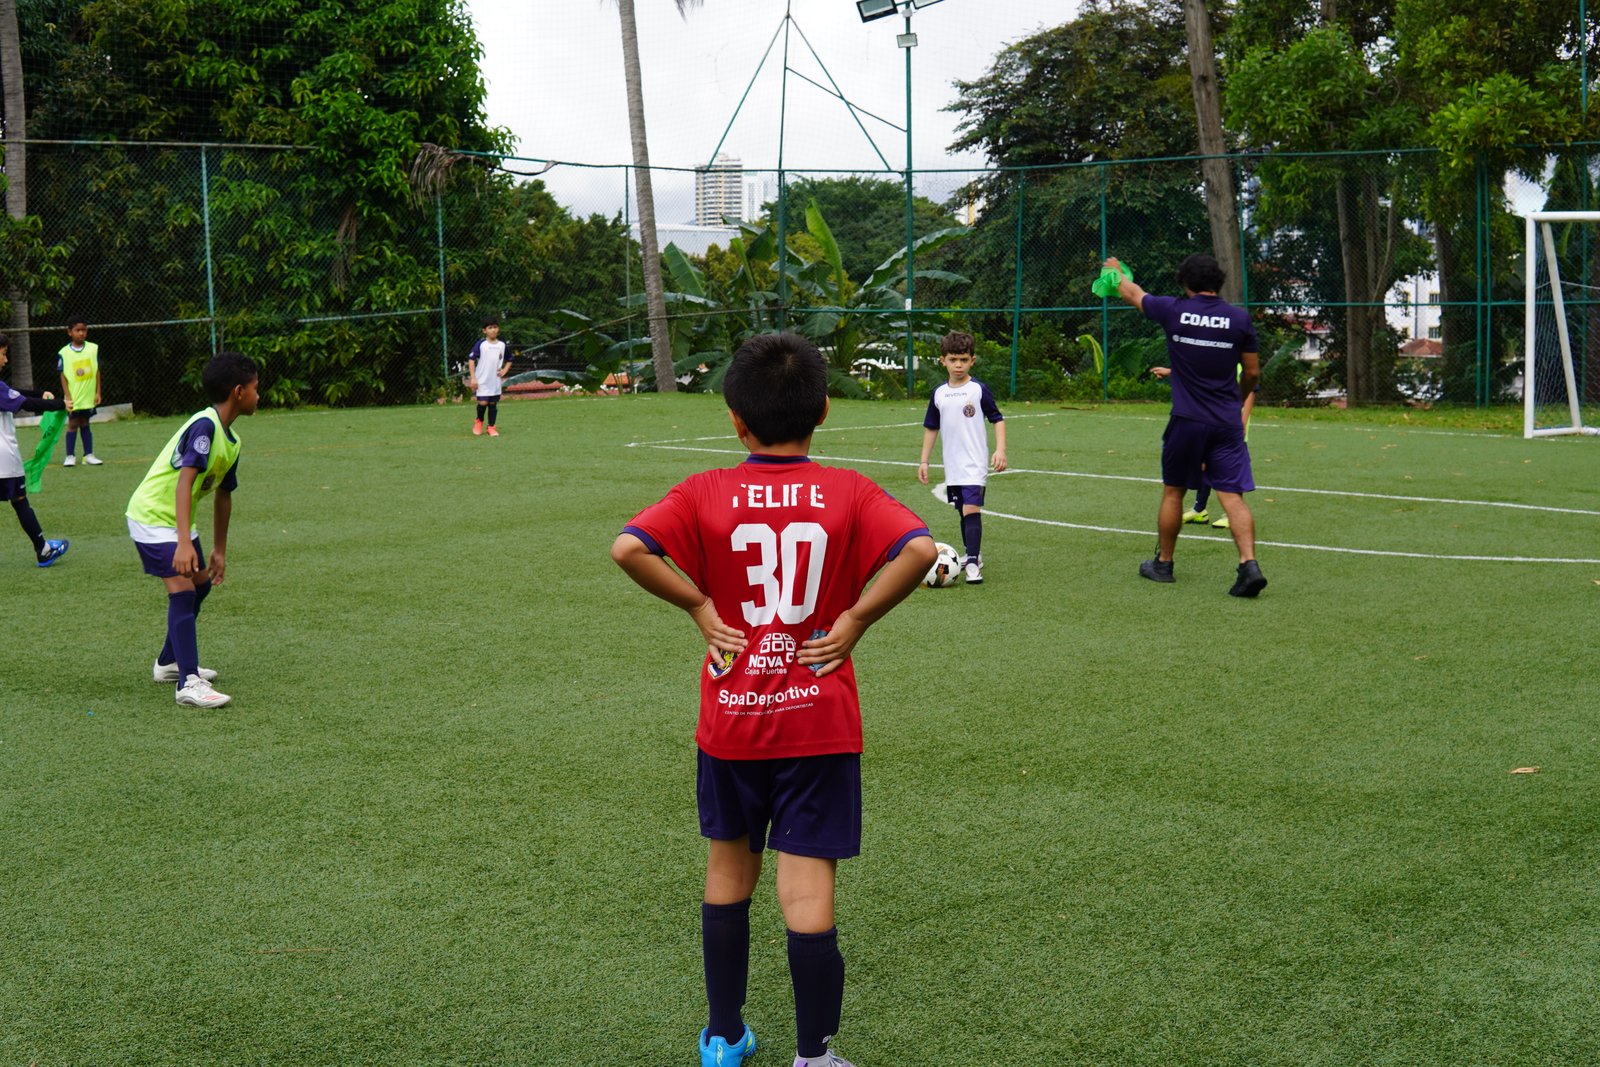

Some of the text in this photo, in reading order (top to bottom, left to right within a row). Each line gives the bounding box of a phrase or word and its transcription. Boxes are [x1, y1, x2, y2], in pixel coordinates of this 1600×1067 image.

[1180, 312, 1230, 329] COACH
[731, 522, 828, 627] 30
[748, 654, 784, 668] NOVA
[761, 667, 788, 675] Fuertes
[718, 684, 820, 708] SpaDeportivo
